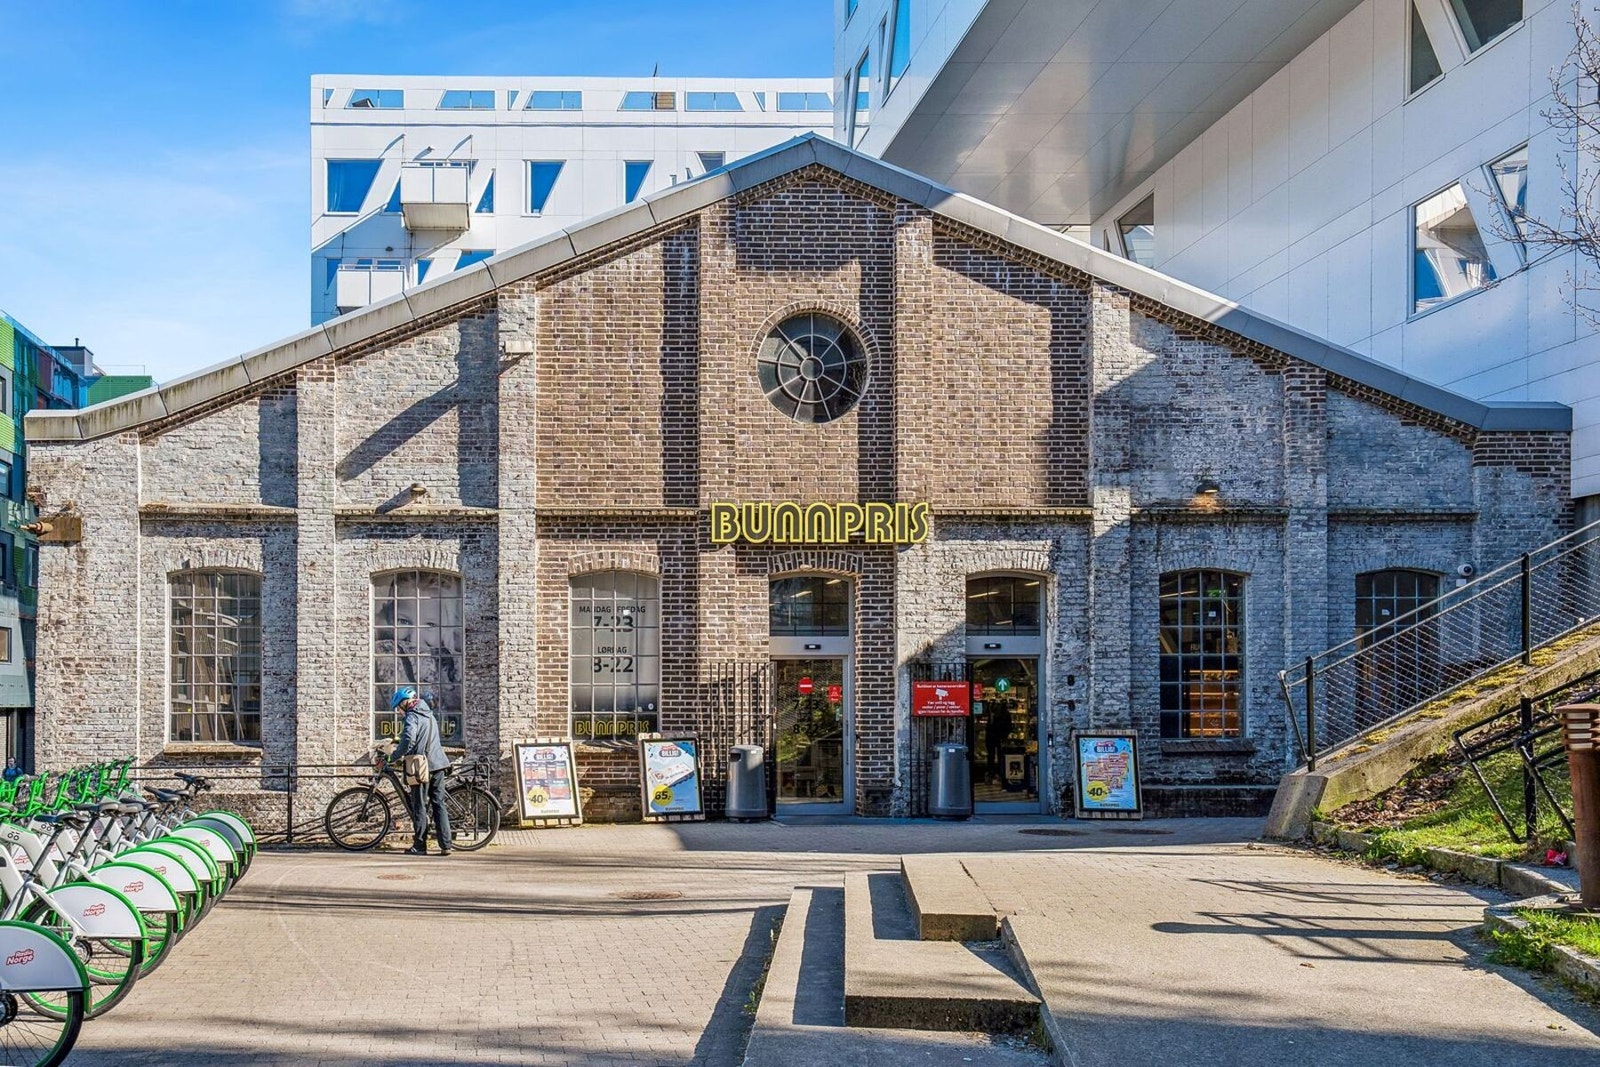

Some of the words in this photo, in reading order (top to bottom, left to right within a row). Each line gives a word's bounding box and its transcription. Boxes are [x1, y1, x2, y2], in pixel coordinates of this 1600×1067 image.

[711, 502, 929, 543] BUNNPRIS
[591, 656, 633, 672] 8-22
[7, 954, 34, 965] Norge
